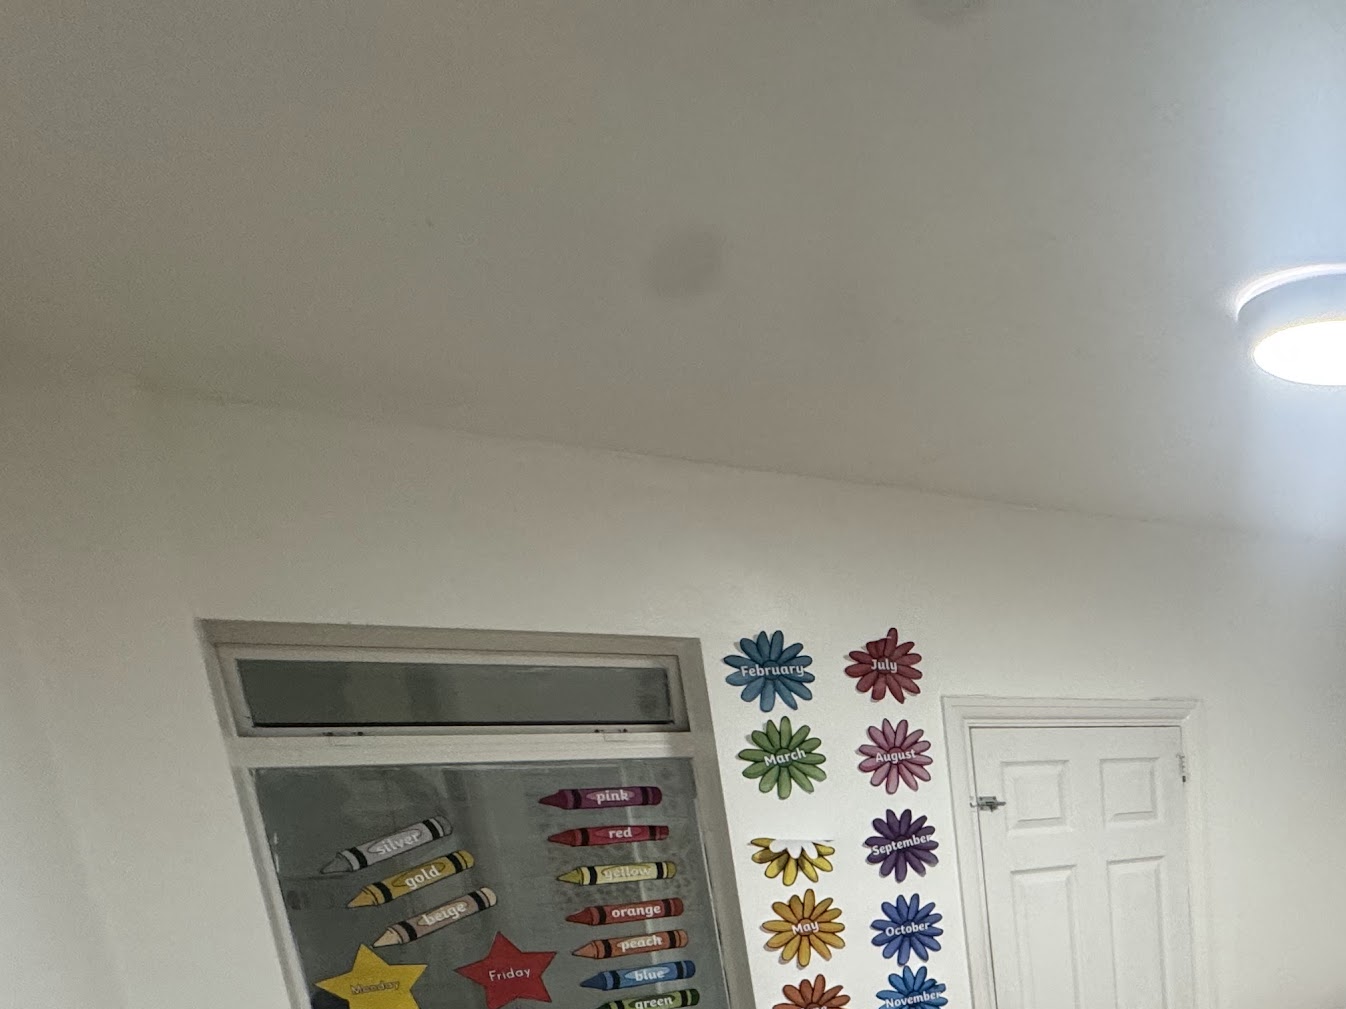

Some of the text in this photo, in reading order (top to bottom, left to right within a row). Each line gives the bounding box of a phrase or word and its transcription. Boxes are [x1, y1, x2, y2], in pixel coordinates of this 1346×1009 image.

[740, 663, 805, 678] February
[870, 658, 898, 673] July
[763, 748, 807, 767] March
[875, 748, 917, 765] August
[595, 788, 631, 805] pink
[608, 827, 633, 838] red
[375, 831, 421, 855] silver
[872, 833, 933, 856] September
[404, 865, 442, 890] gold
[603, 865, 652, 881] yellow
[424, 901, 468, 926] beige
[611, 904, 662, 918] orange
[791, 921, 820, 935] May
[885, 920, 930, 937] October
[620, 934, 663, 953] peach
[488, 966, 531, 982] Friday
[635, 967, 665, 982] blue
[351, 979, 400, 995] Monday
[885, 990, 942, 1008] November
